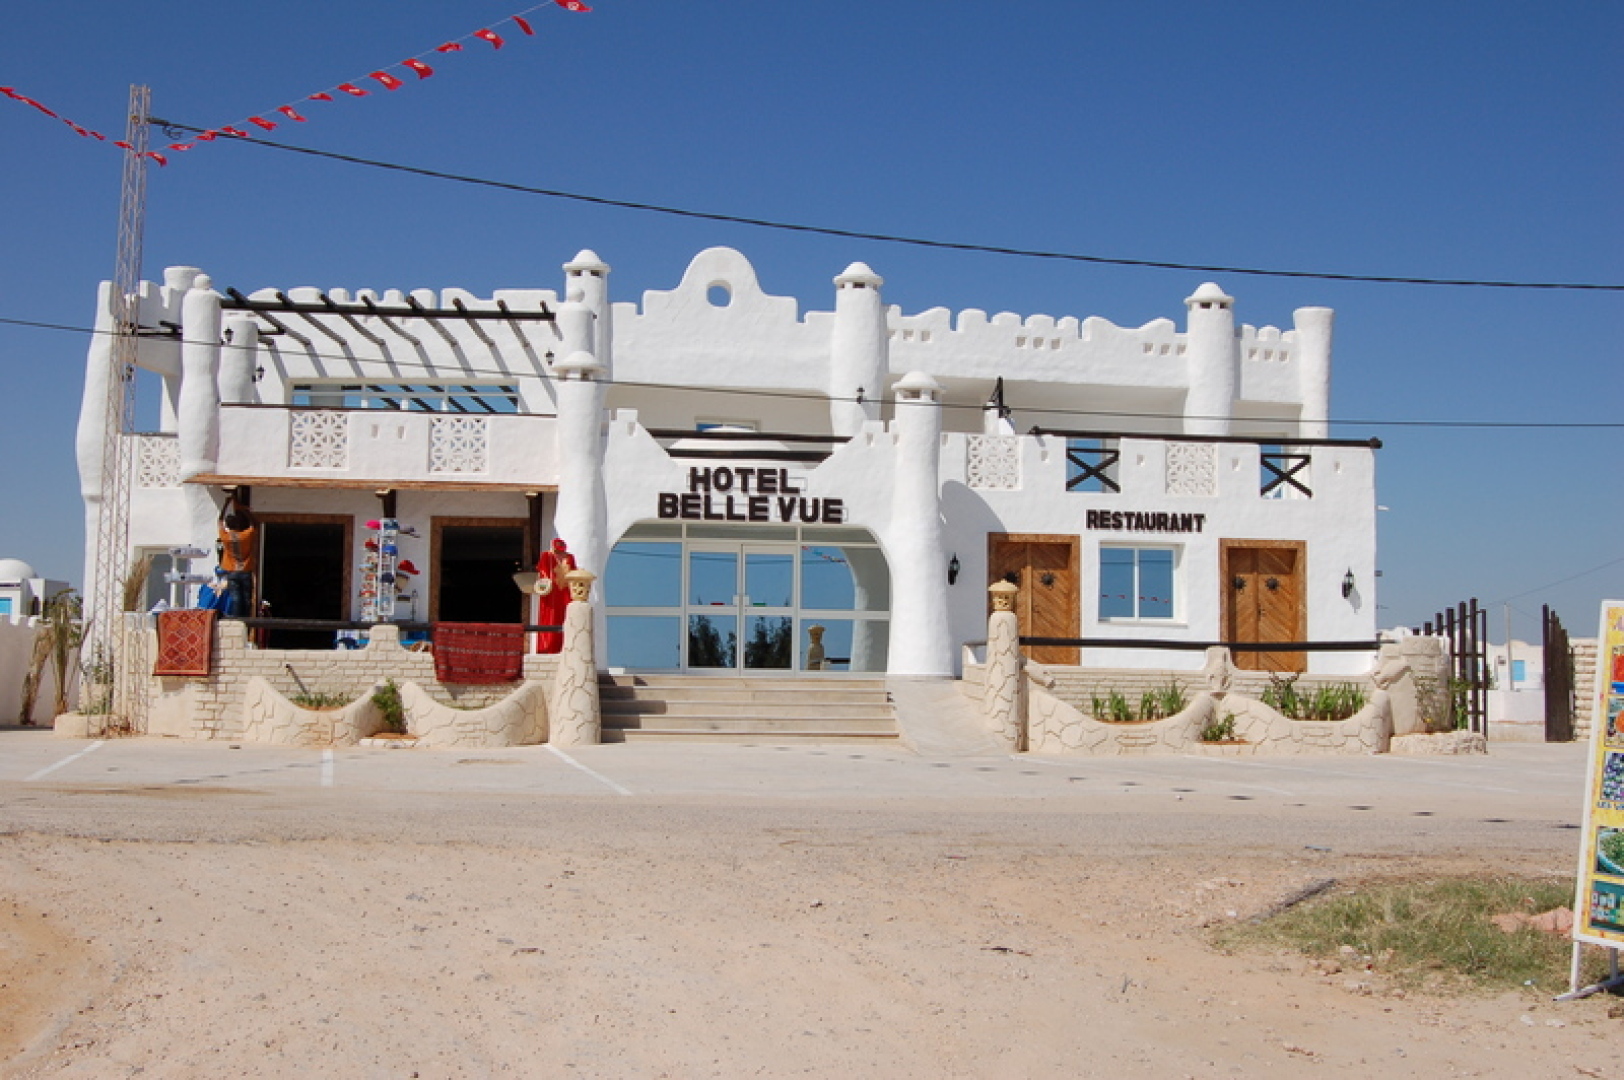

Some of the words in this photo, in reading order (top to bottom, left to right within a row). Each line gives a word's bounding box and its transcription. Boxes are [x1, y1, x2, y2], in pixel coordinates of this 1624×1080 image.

[690, 466, 800, 493] HOTEL
[659, 493, 768, 520] BELLE
[777, 497, 842, 523] VUE
[1087, 510, 1204, 532] RESTAURANT
